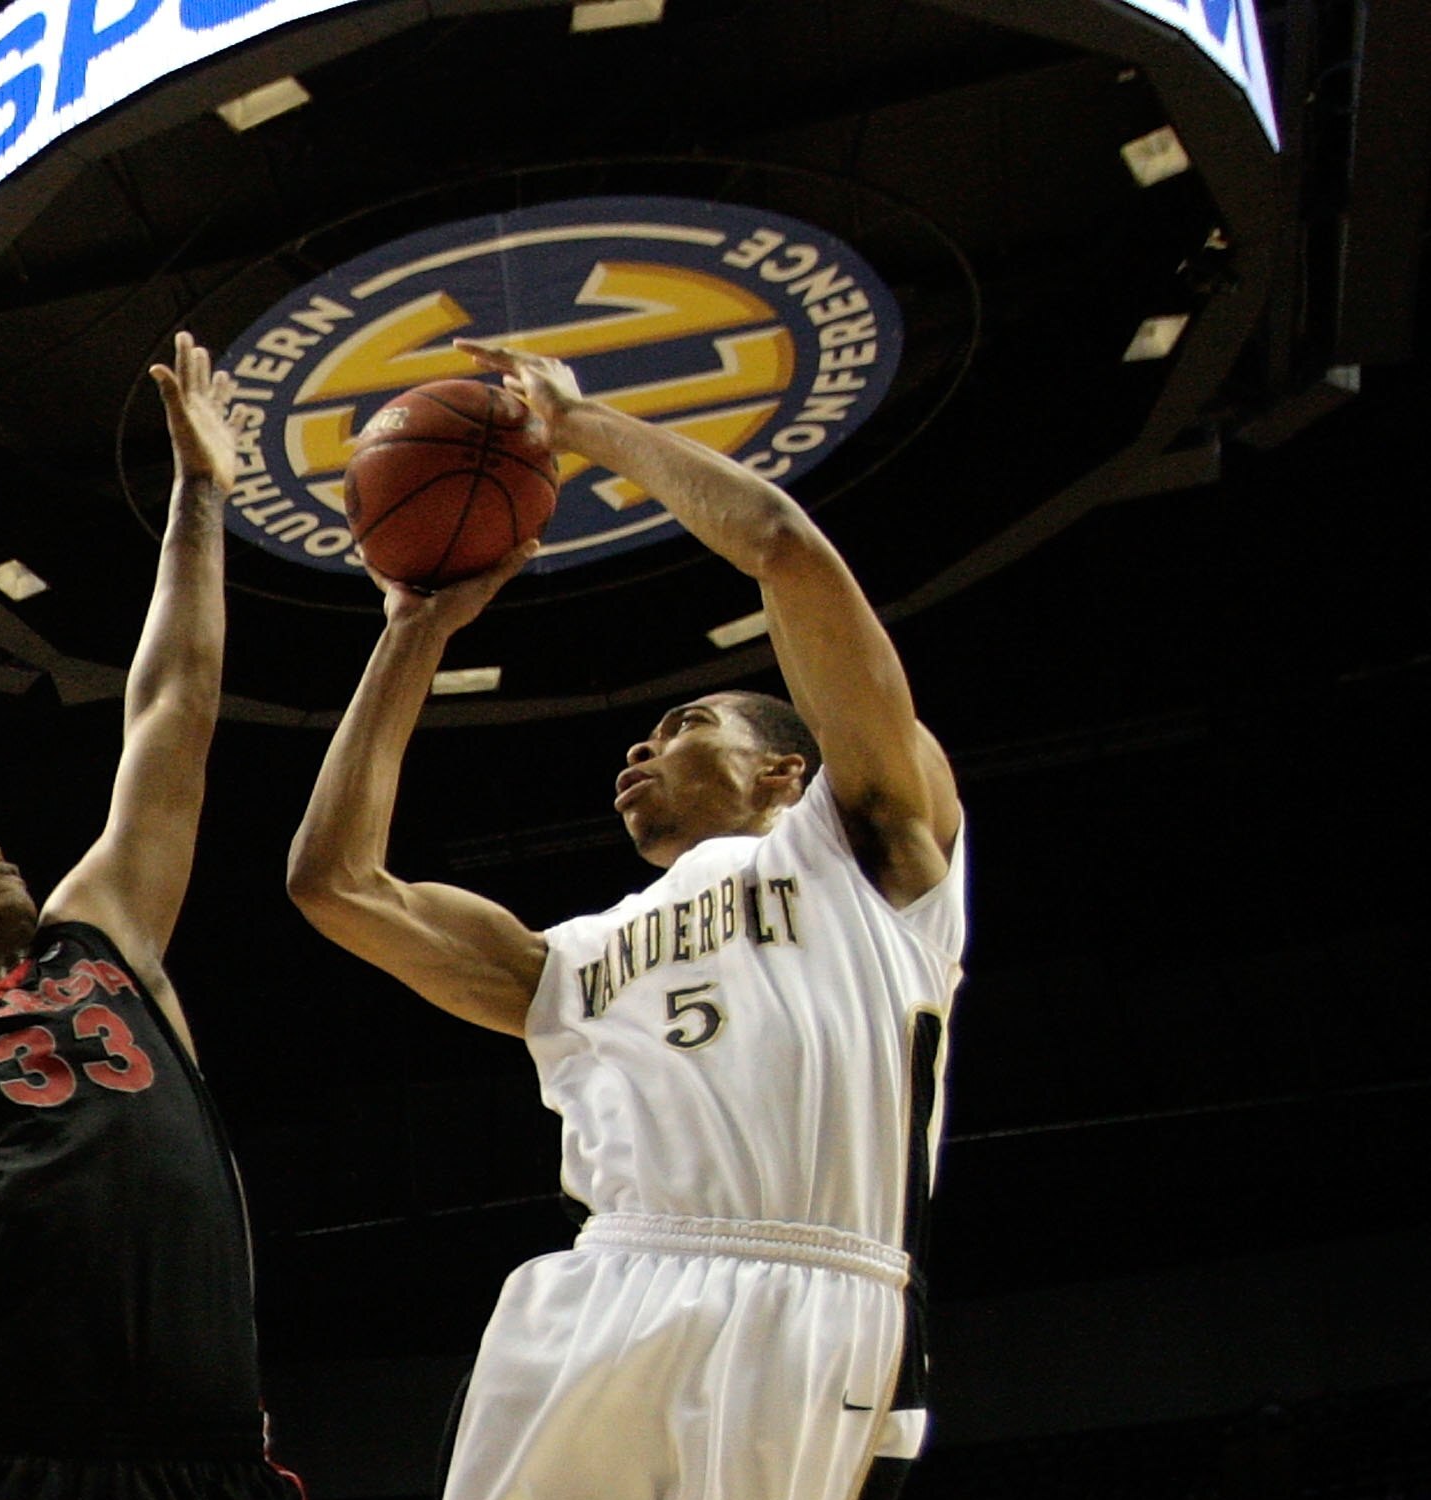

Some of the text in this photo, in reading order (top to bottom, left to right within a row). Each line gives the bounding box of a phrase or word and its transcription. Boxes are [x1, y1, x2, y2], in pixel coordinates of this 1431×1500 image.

[226, 294, 365, 567] OUTHEASTERN
[723, 227, 878, 480] CONFERENCE
[665, 982, 724, 1049] 5
